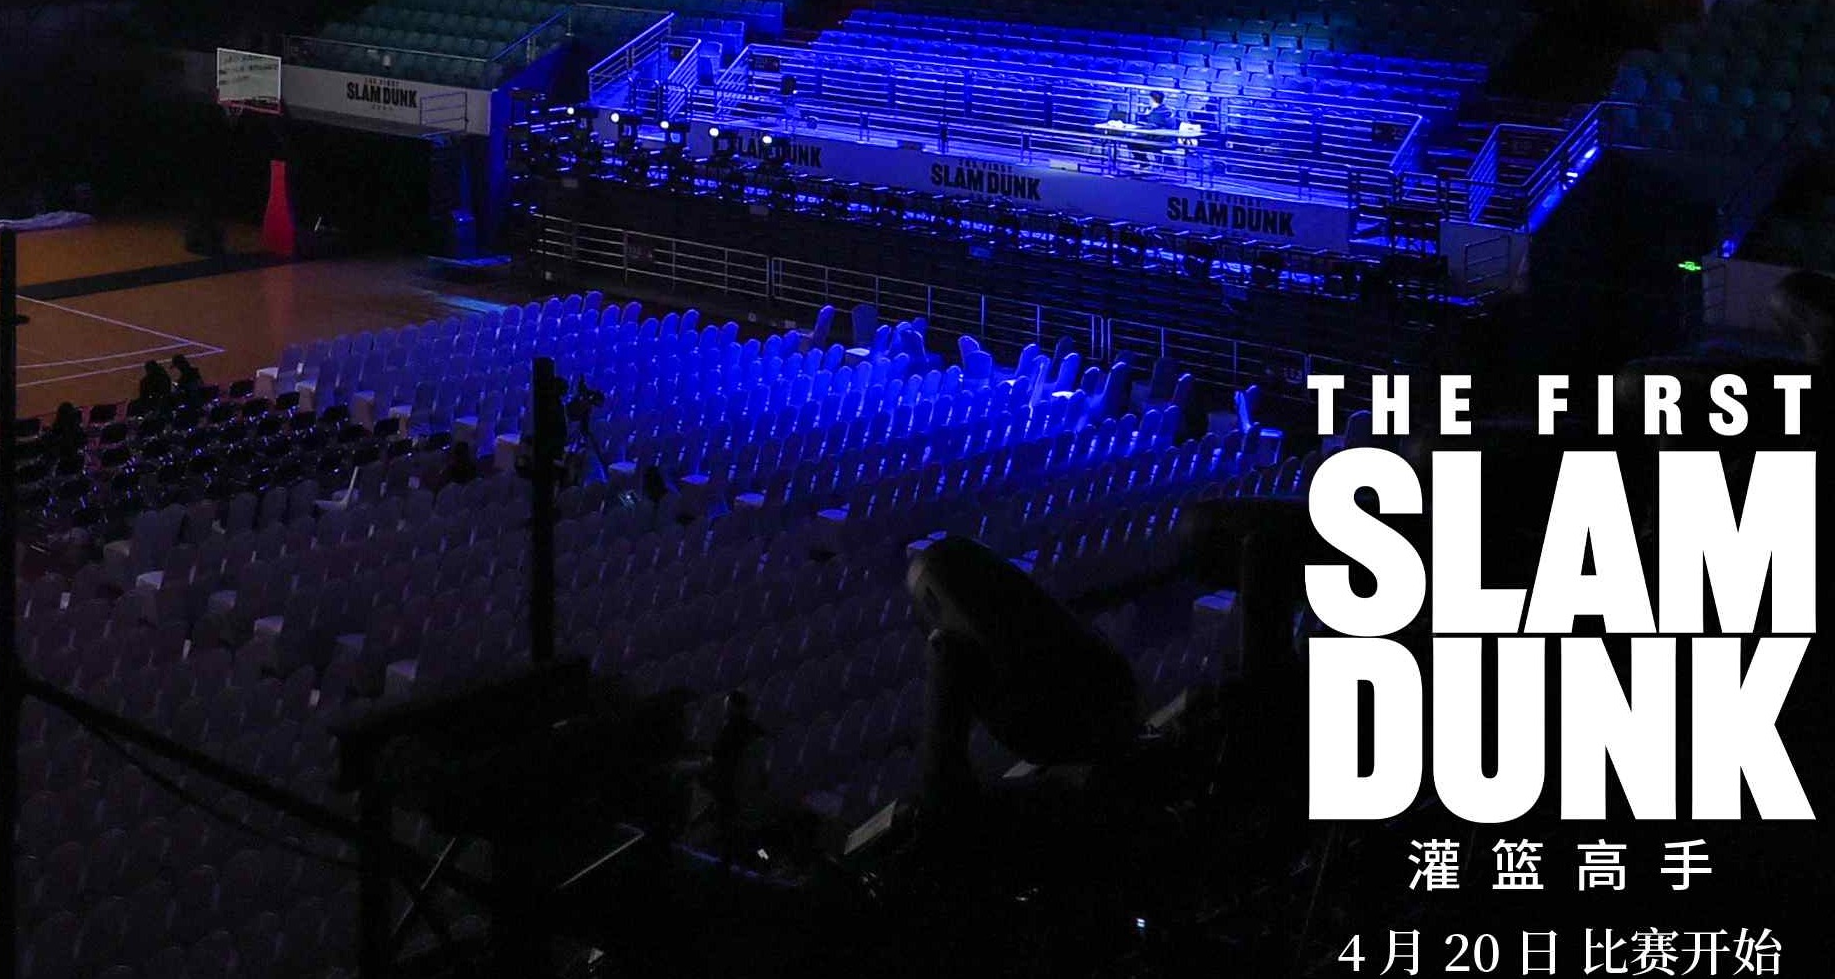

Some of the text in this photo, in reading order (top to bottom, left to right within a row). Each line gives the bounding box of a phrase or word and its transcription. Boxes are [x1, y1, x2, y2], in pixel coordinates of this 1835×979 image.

[347, 81, 417, 108] SLAM DUNK
[931, 163, 1041, 201] SLAM DUNK
[1167, 196, 1228, 227] SLAM
[1232, 205, 1294, 237] DUNK
